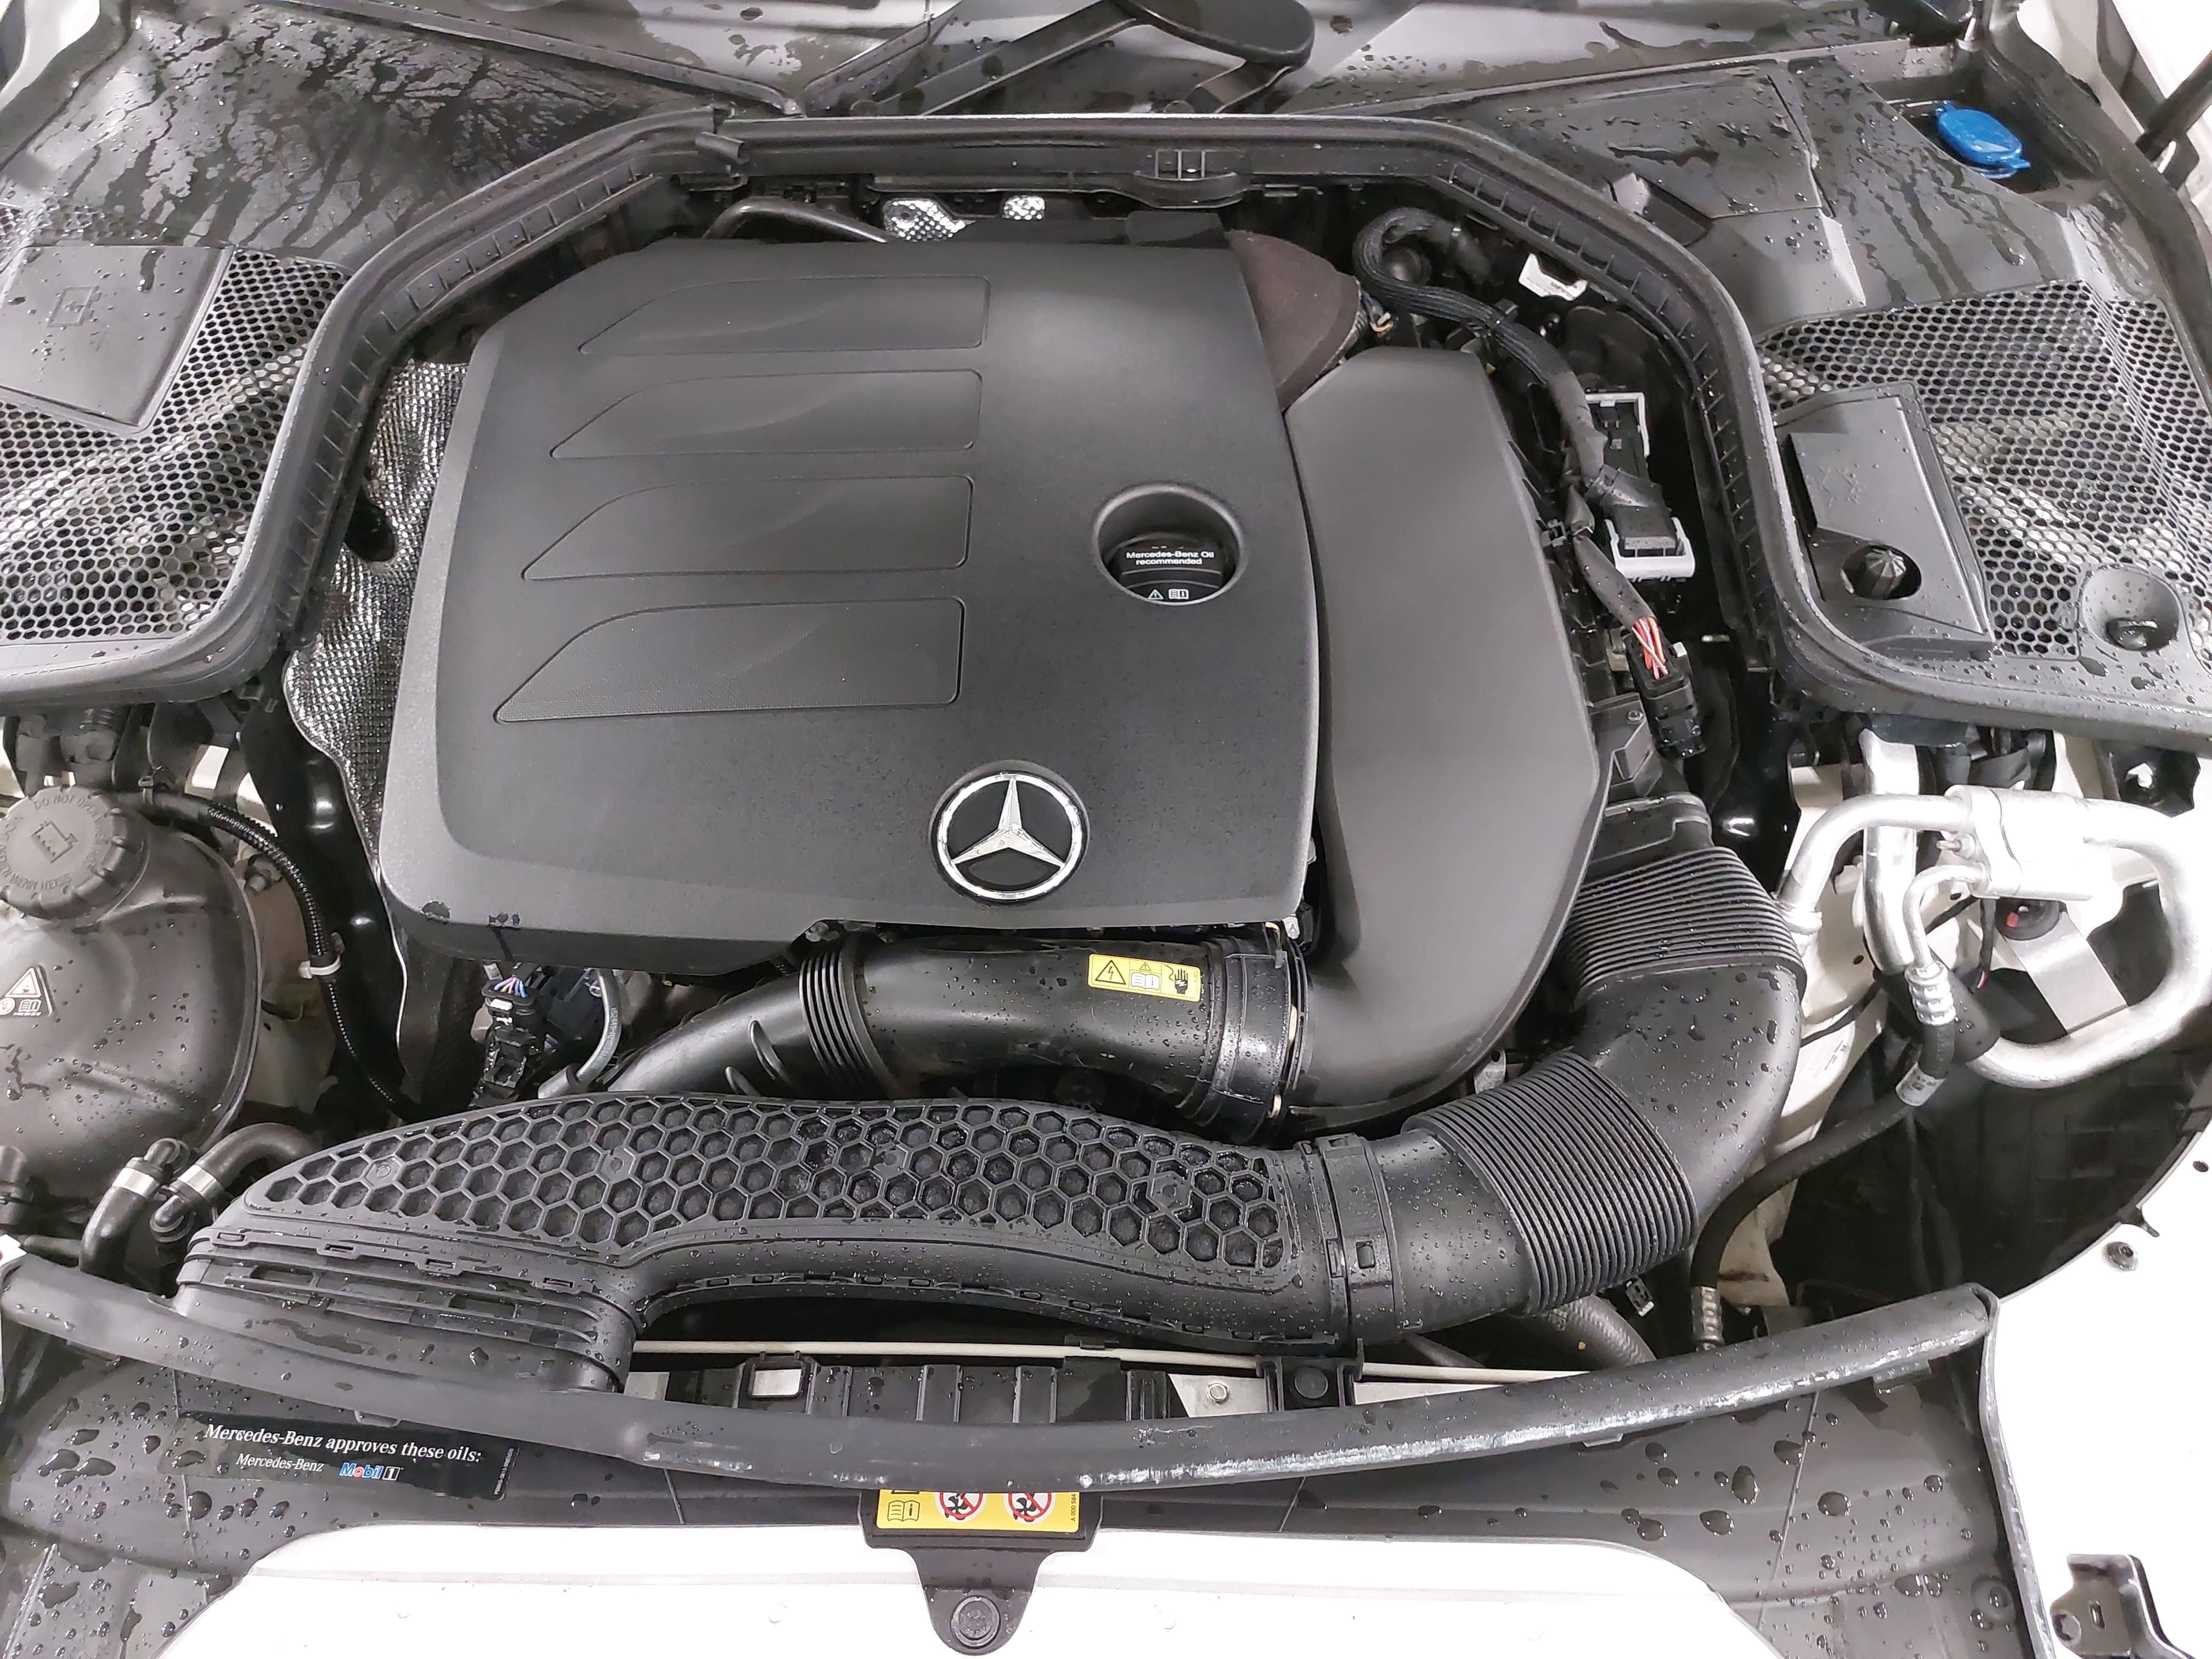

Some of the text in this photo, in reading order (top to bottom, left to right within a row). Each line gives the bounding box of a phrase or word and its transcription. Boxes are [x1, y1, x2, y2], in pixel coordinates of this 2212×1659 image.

[1126, 551, 1199, 559] Mercedes-Benz
[1136, 557, 1202, 566] recommended
[53, 794, 75, 804] NOT
[204, 1424, 483, 1463] Mercedes-Benz approves these oils:
[235, 1453, 325, 1472] Mercedes-Benz
[339, 1462, 383, 1479] Mobil
